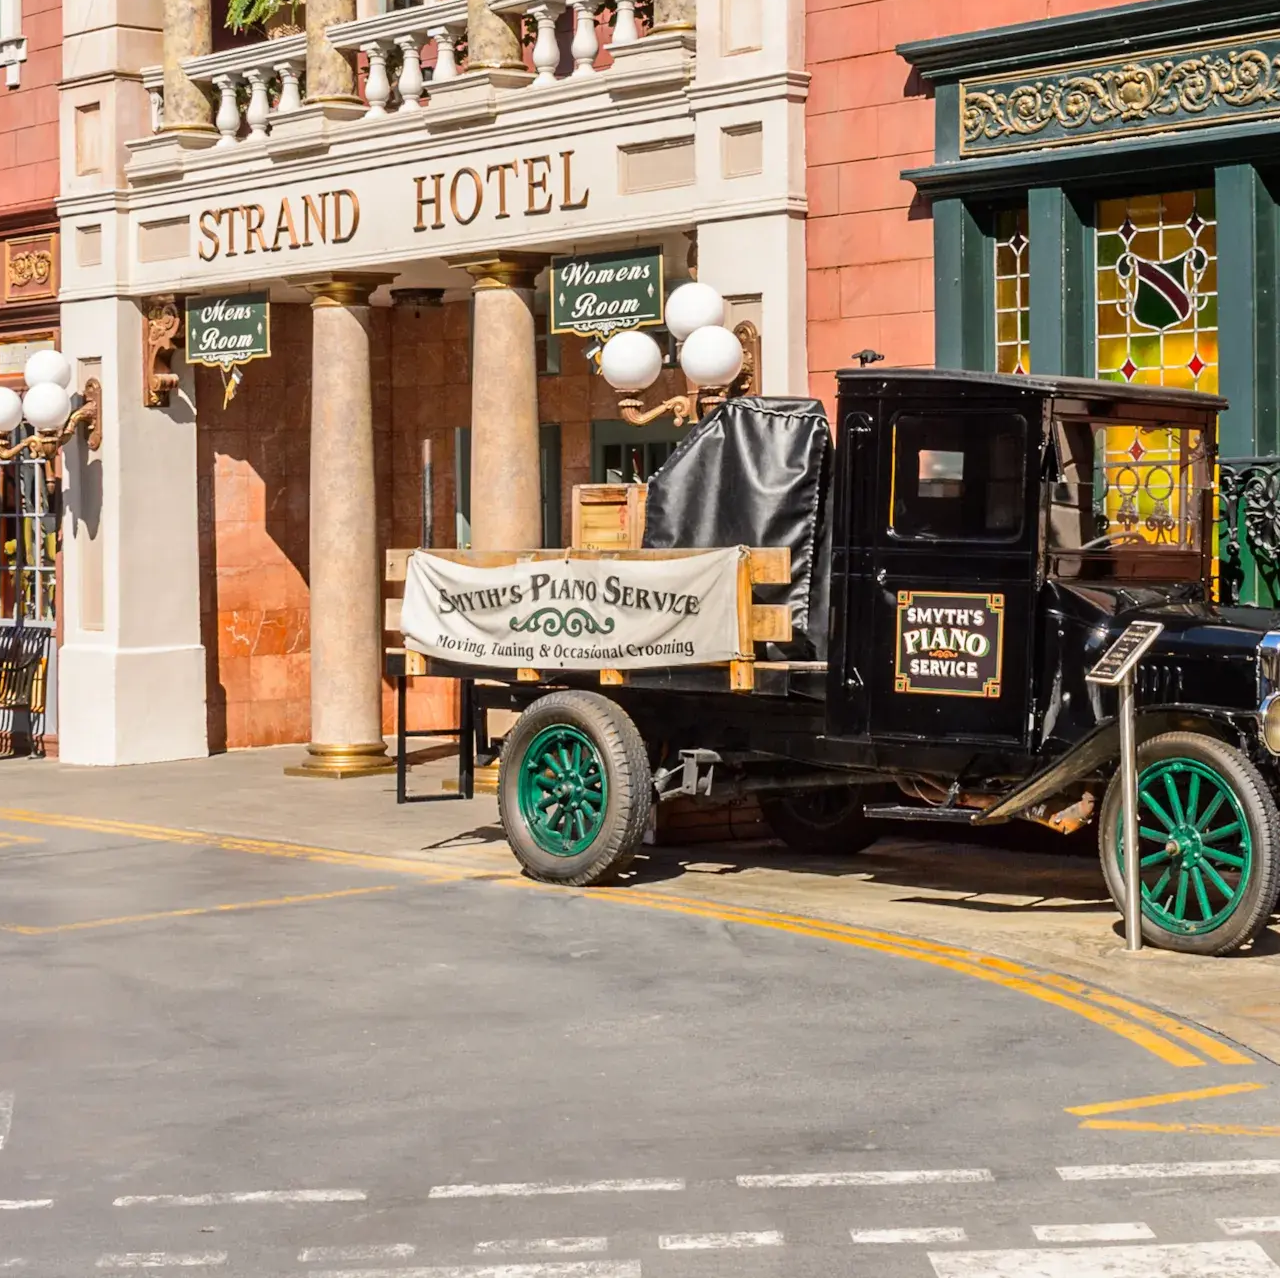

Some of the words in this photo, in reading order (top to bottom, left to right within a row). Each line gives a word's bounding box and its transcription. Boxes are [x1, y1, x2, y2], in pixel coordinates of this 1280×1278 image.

[198, 188, 360, 262] STRAND
[413, 149, 590, 233] HOTEL
[561, 261, 650, 287] Womens
[201, 299, 251, 323] Mens
[571, 292, 640, 318] Room
[199, 328, 253, 350] Room
[530, 573, 596, 602] PIANO
[603, 576, 701, 615] SERVICE
[906, 607, 985, 626] SMYTH'S
[436, 634, 487, 657] Moving,
[491, 642, 534, 661] Tuning
[539, 644, 551, 658] &
[553, 643, 624, 659] Occasional
[626, 639, 695, 657] Crooning
[903, 627, 990, 657] PIANO
[910, 659, 978, 678] SERVICE
